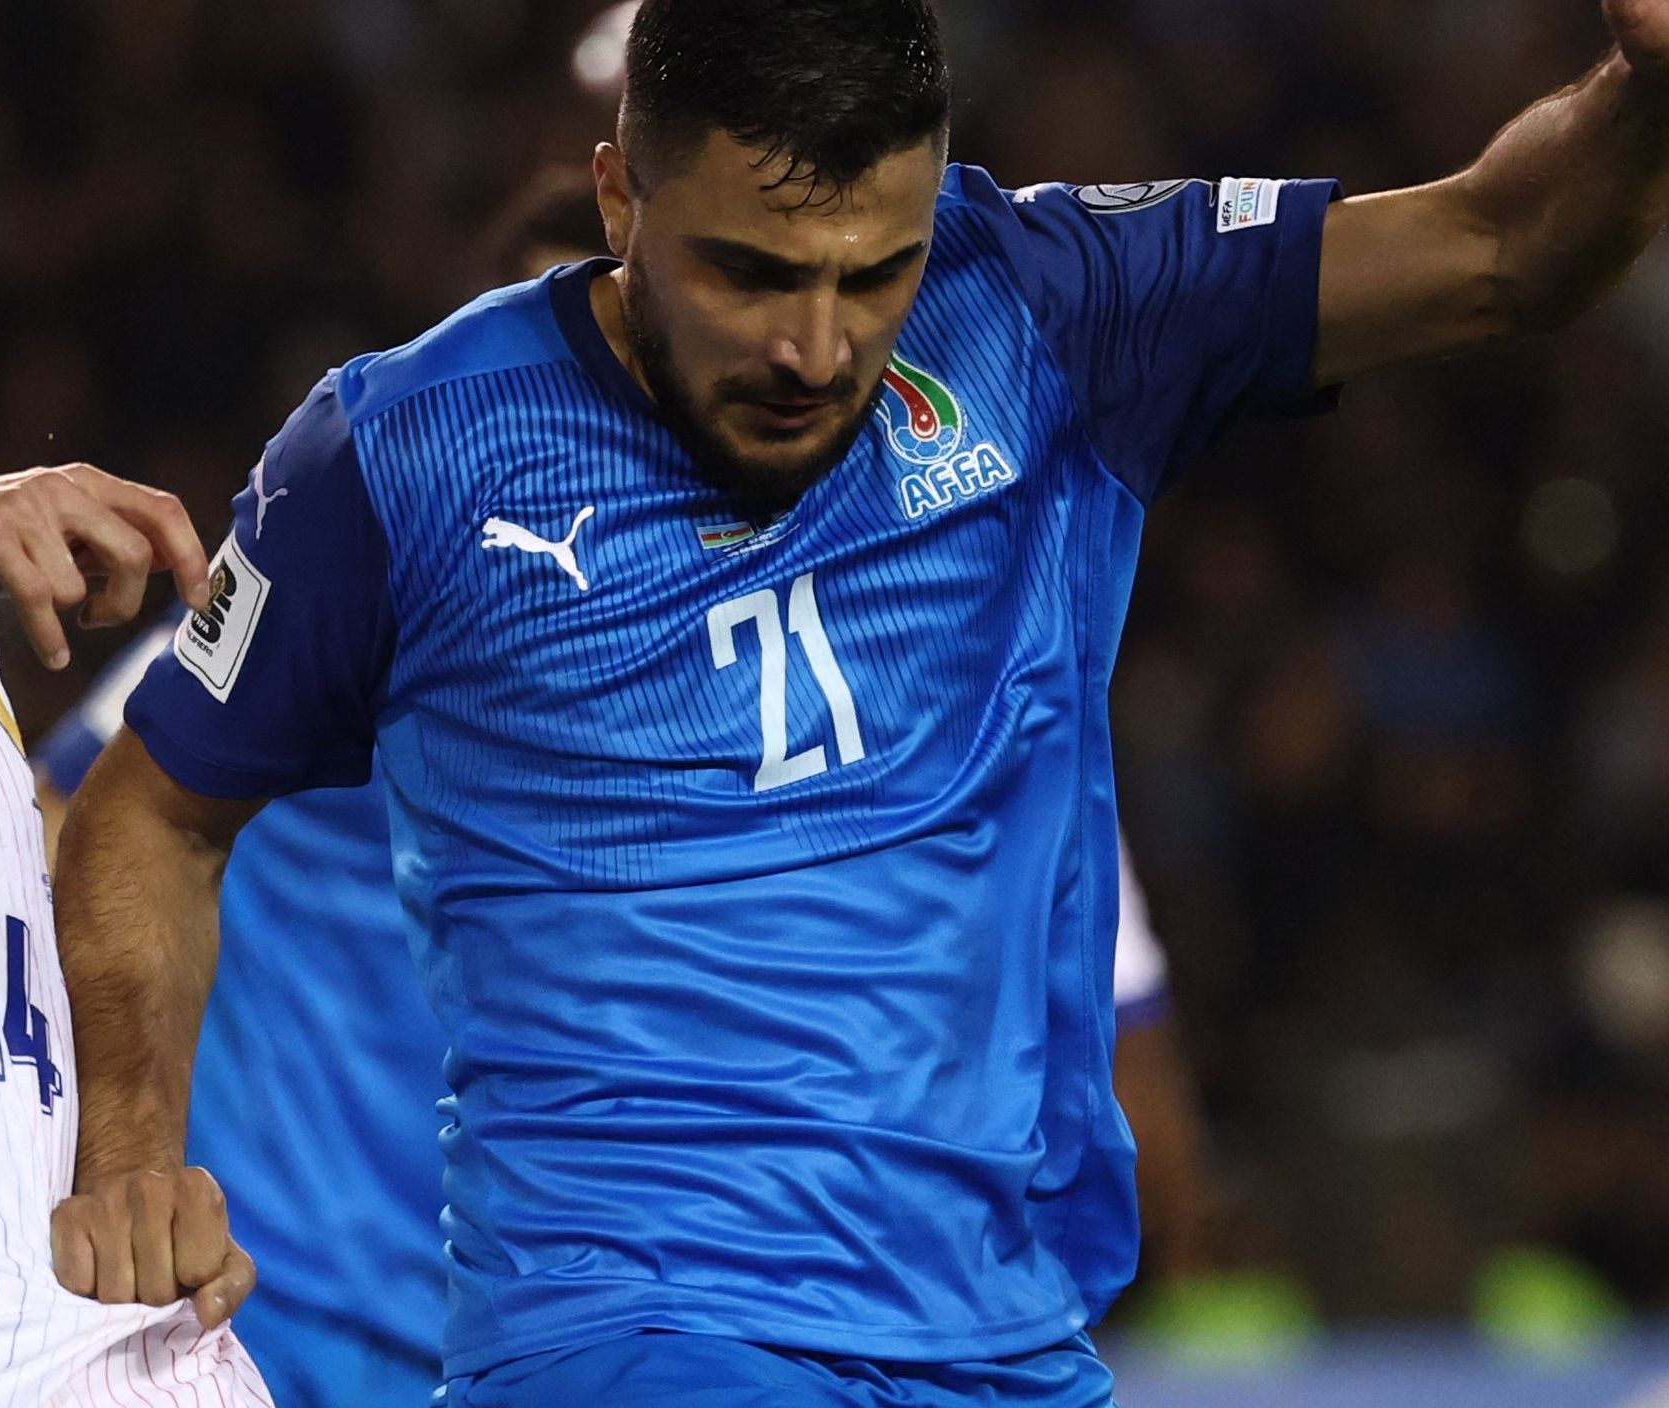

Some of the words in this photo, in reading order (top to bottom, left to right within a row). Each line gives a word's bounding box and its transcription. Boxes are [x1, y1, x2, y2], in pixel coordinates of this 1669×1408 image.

[1221, 200, 1233, 227] UEFA
[901, 442, 1014, 519] AFFA
[707, 572, 866, 792] 21
